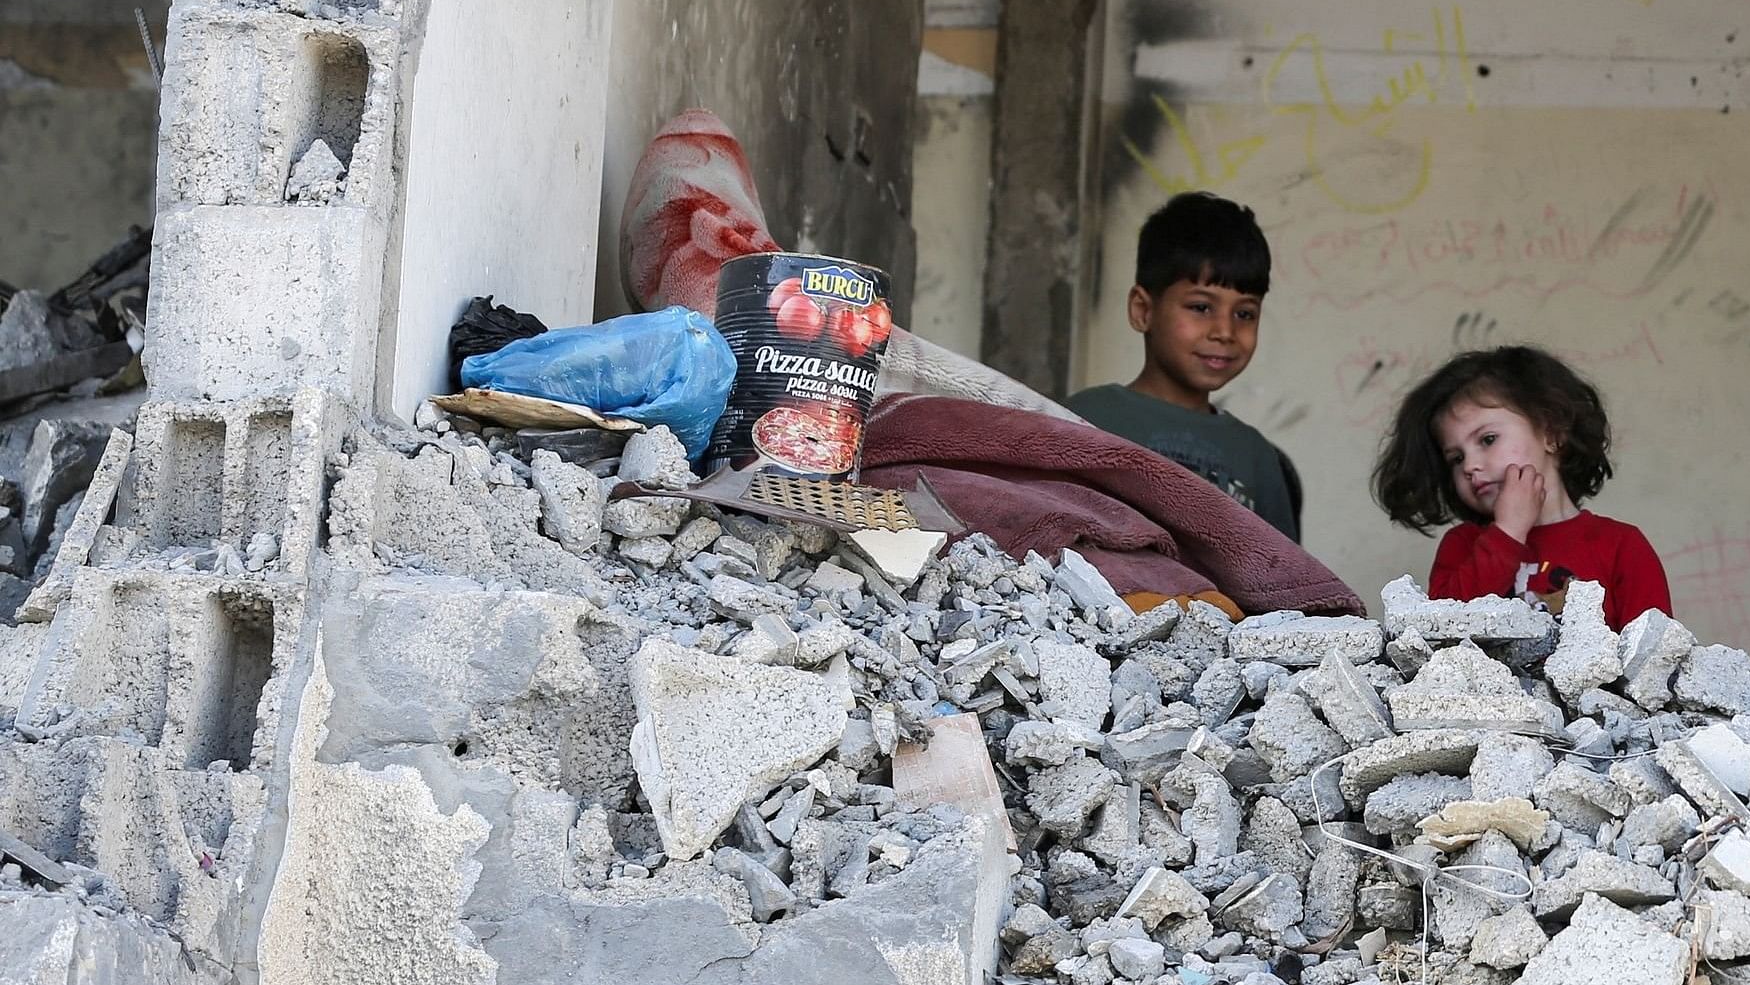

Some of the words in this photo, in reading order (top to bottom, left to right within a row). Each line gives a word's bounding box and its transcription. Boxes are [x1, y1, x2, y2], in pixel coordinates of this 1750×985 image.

[806, 270, 870, 302] BURCU
[754, 345, 825, 376] Pizza
[785, 375, 827, 393] pizza
[830, 383, 859, 401] sosu
